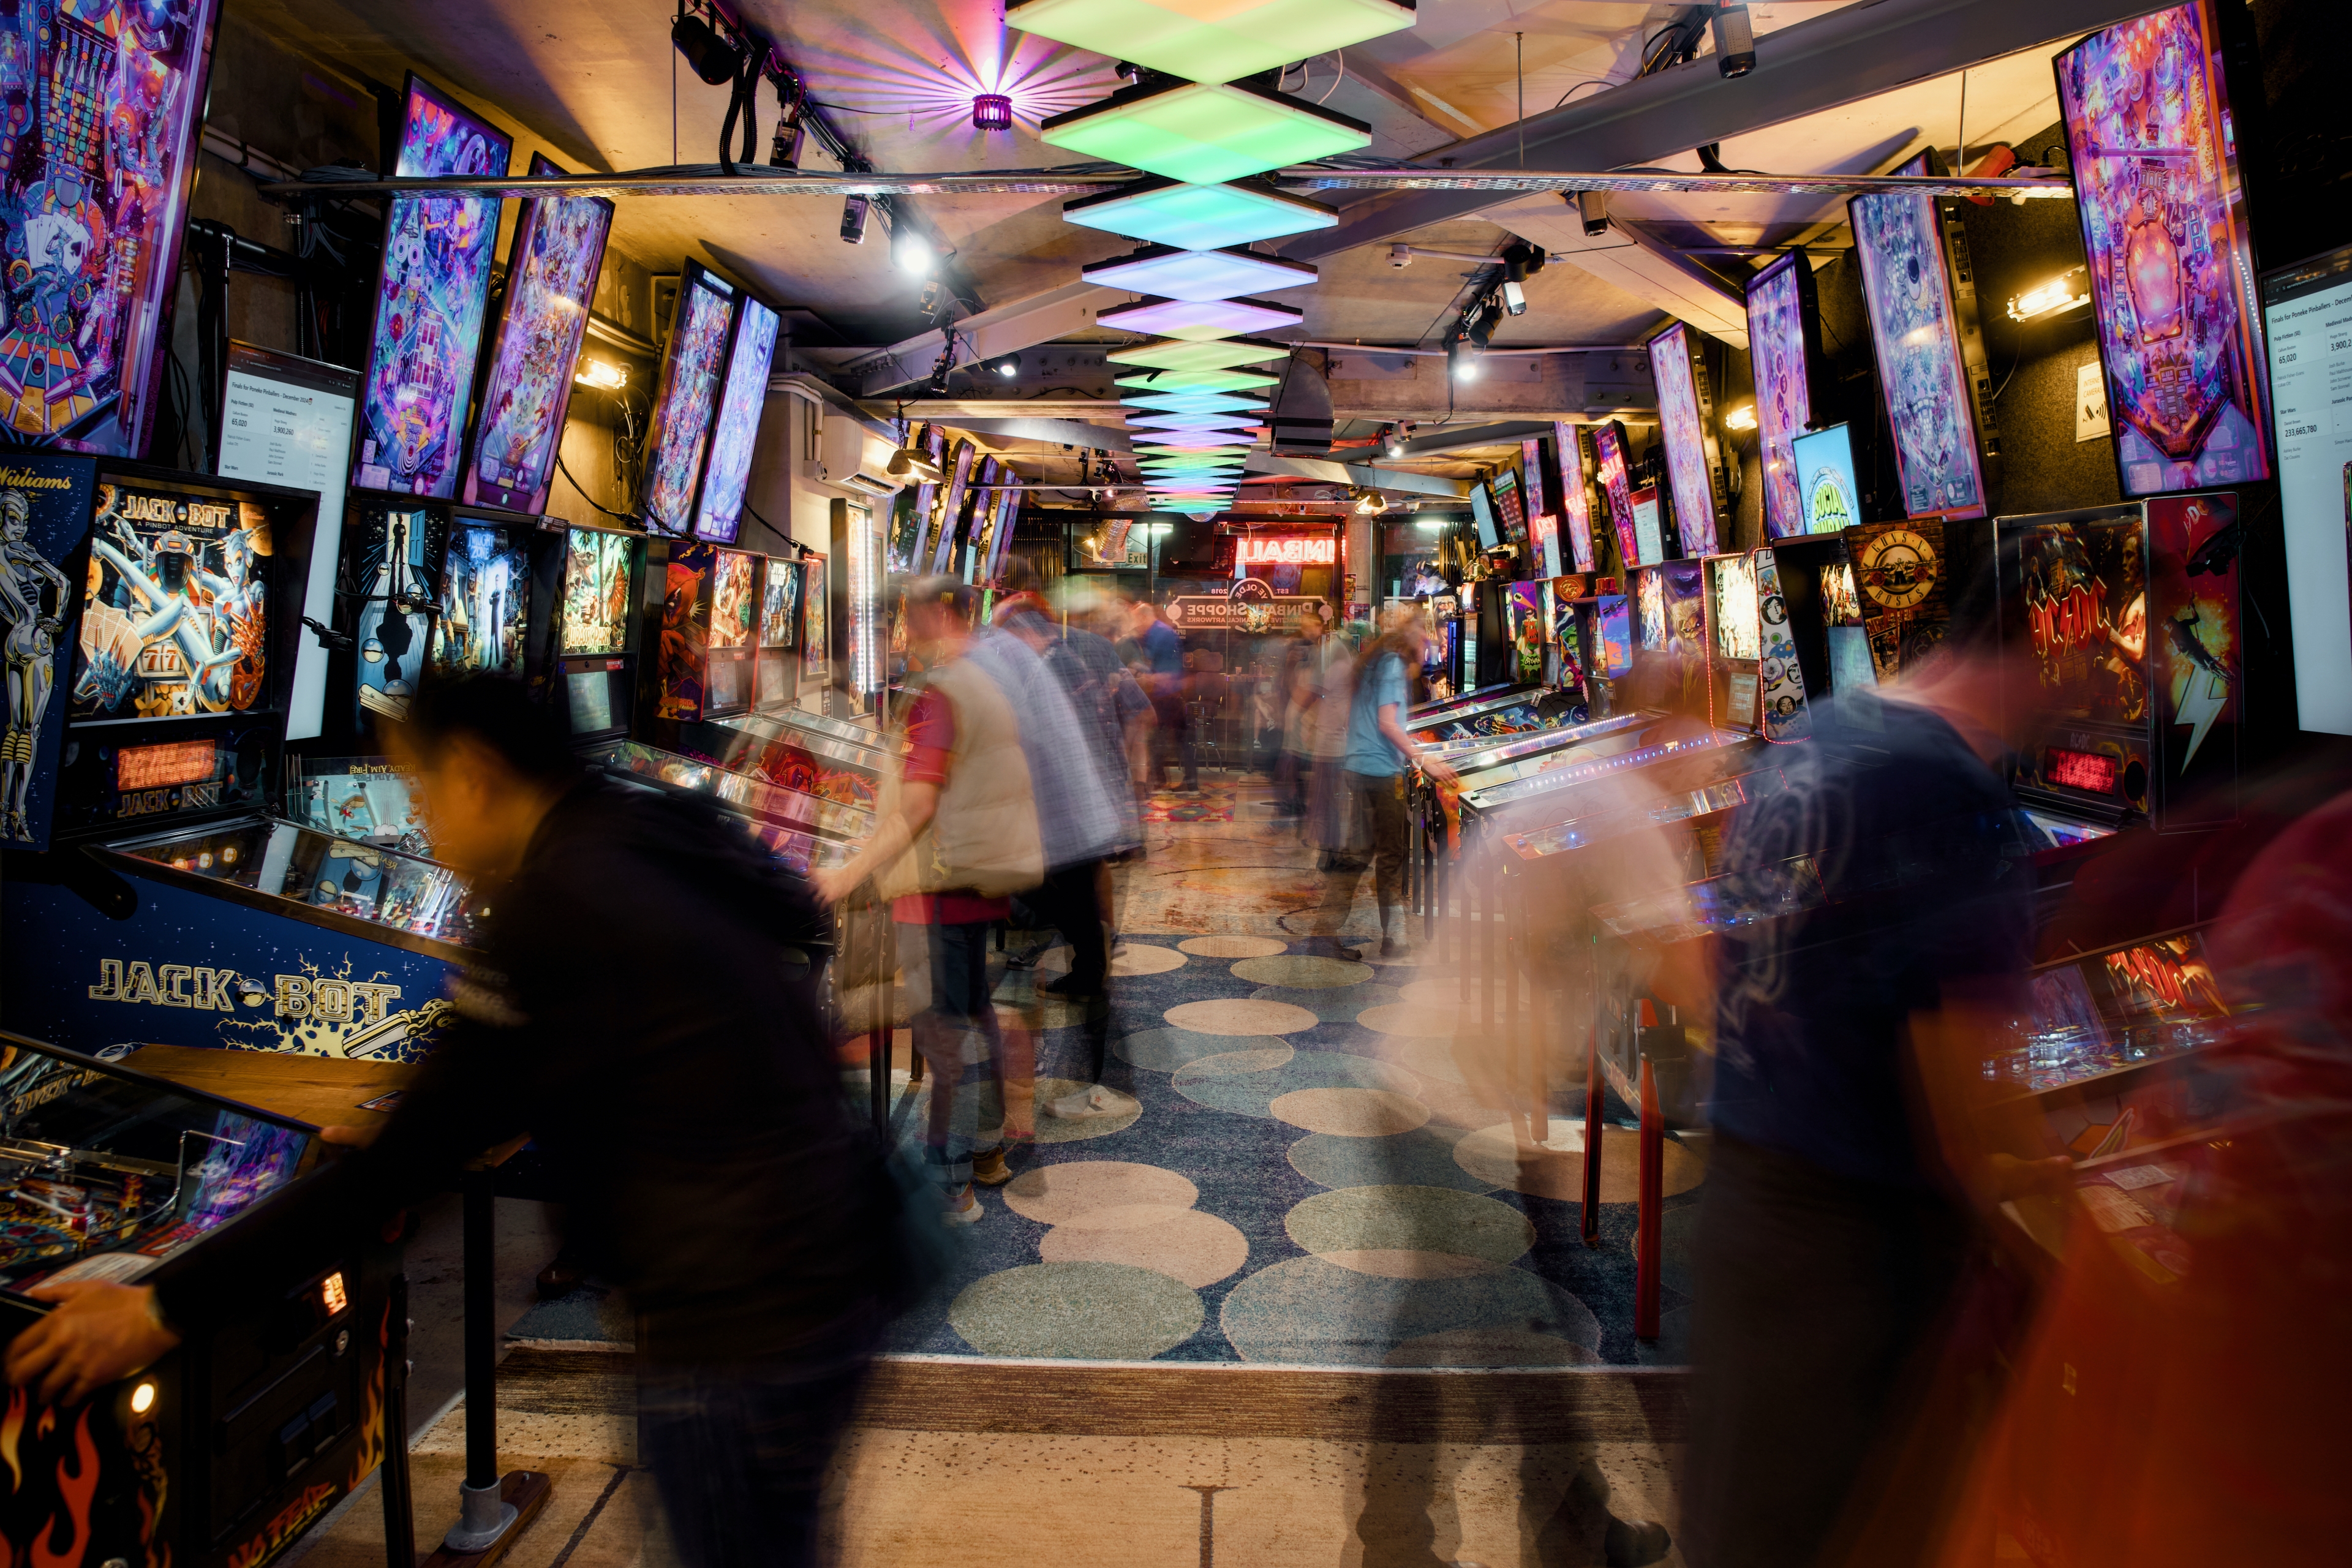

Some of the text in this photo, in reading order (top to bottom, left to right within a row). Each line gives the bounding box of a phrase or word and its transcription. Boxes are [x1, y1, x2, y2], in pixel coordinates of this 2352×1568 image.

[2271, 315, 2283, 324] Finals
[2292, 309, 2308, 318] Poneke
[2309, 303, 2331, 314] Pinballers
[2326, 319, 2342, 328] Medieval
[2278, 353, 2297, 364] 65,020
[2084, 376, 2102, 387] INTERNET
[263, 388, 280, 398] Pinballers
[282, 393, 300, 402] December
[2084, 386, 2103, 398] CAMERAS
[232, 418, 247, 427] 65,020
[405, 420, 424, 434] TWILIGHT
[273, 426, 294, 435] 3,900,260
[2285, 424, 2317, 437] 233,665,780
[407, 432, 420, 443] ZONE
[1814, 483, 1847, 521] SOCIAL
[123, 495, 231, 529] JACK BOT
[145, 522, 172, 530] PINBOT
[173, 524, 214, 534] ADVENTURE
[467, 530, 495, 548] TWILIGHT
[1872, 533, 1907, 553] GUNS
[471, 546, 490, 560] ZONE
[1128, 552, 1147, 565] Exit
[773, 562, 786, 575] STAR
[771, 573, 786, 586] WARS
[1875, 588, 1924, 606] ROSES
[566, 624, 612, 650] JURASSIC PARK
[1525, 656, 1540, 666] BATMAN
[659, 696, 698, 711] DEADPOOL
[349, 764, 368, 775] FIRE!
[118, 781, 224, 818] JACK BOT
[88, 958, 236, 1012] JACK
[274, 974, 401, 1025] BOT
[266, 1481, 336, 1549] FEAR
